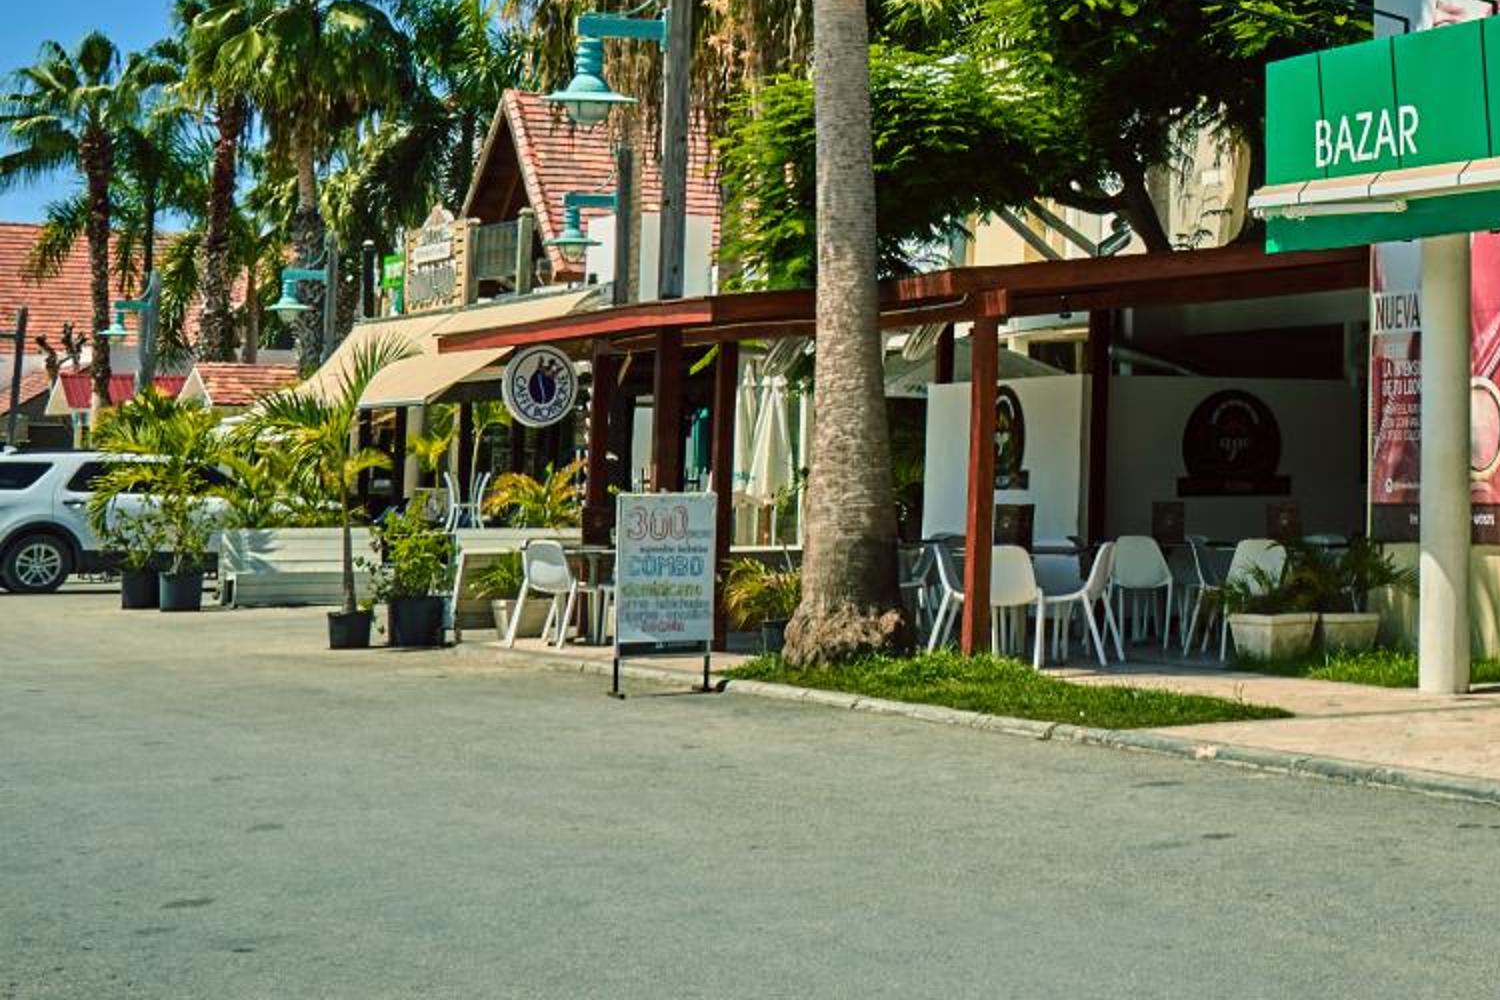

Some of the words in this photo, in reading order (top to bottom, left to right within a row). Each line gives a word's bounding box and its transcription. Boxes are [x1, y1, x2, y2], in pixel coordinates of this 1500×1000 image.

[1314, 104, 1419, 169] BAZAR
[1375, 291, 1421, 331] NUEVA
[627, 505, 688, 541] 300
[626, 554, 704, 577] COMBO
